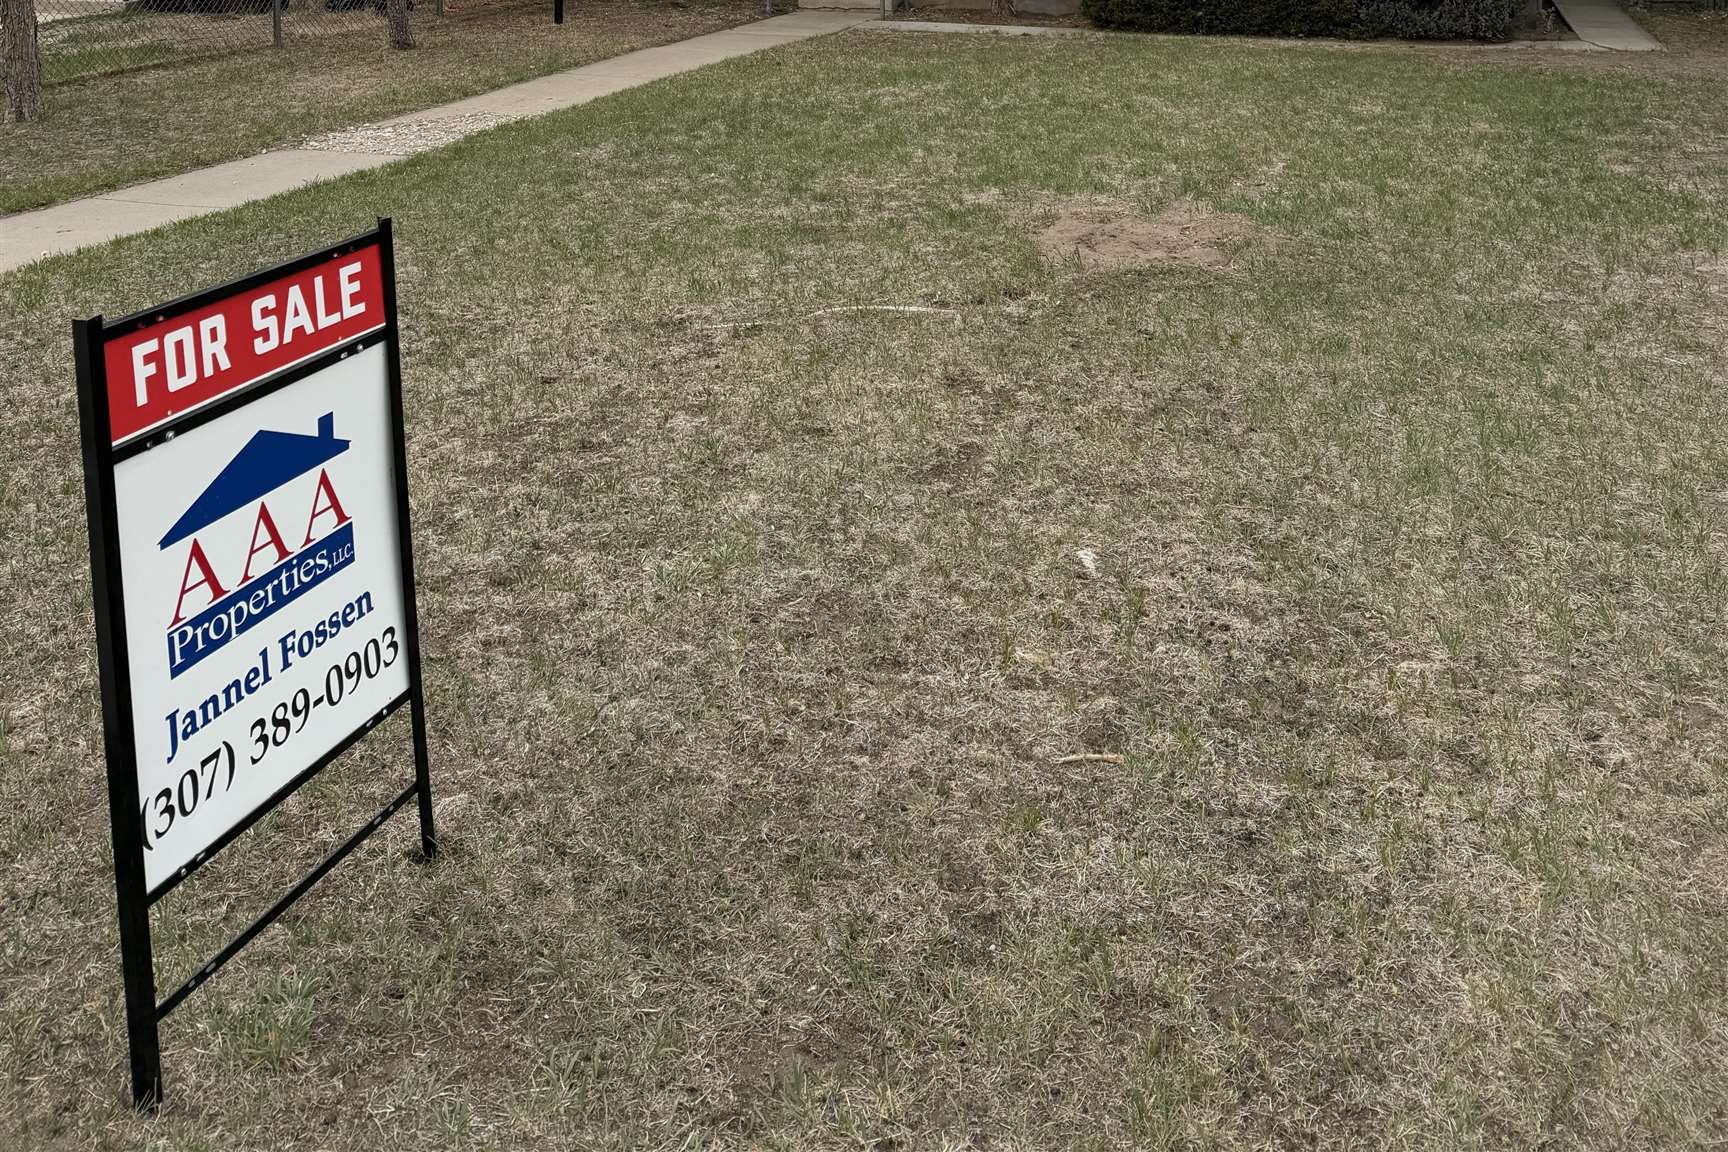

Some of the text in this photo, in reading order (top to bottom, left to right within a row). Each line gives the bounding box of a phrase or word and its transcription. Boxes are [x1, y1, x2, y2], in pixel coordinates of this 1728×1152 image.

[131, 261, 366, 407] FOR SALE
[167, 468, 352, 630] AAA
[140, 626, 399, 851] (307) 389-0903
[165, 591, 374, 764] Jannel Fossen
